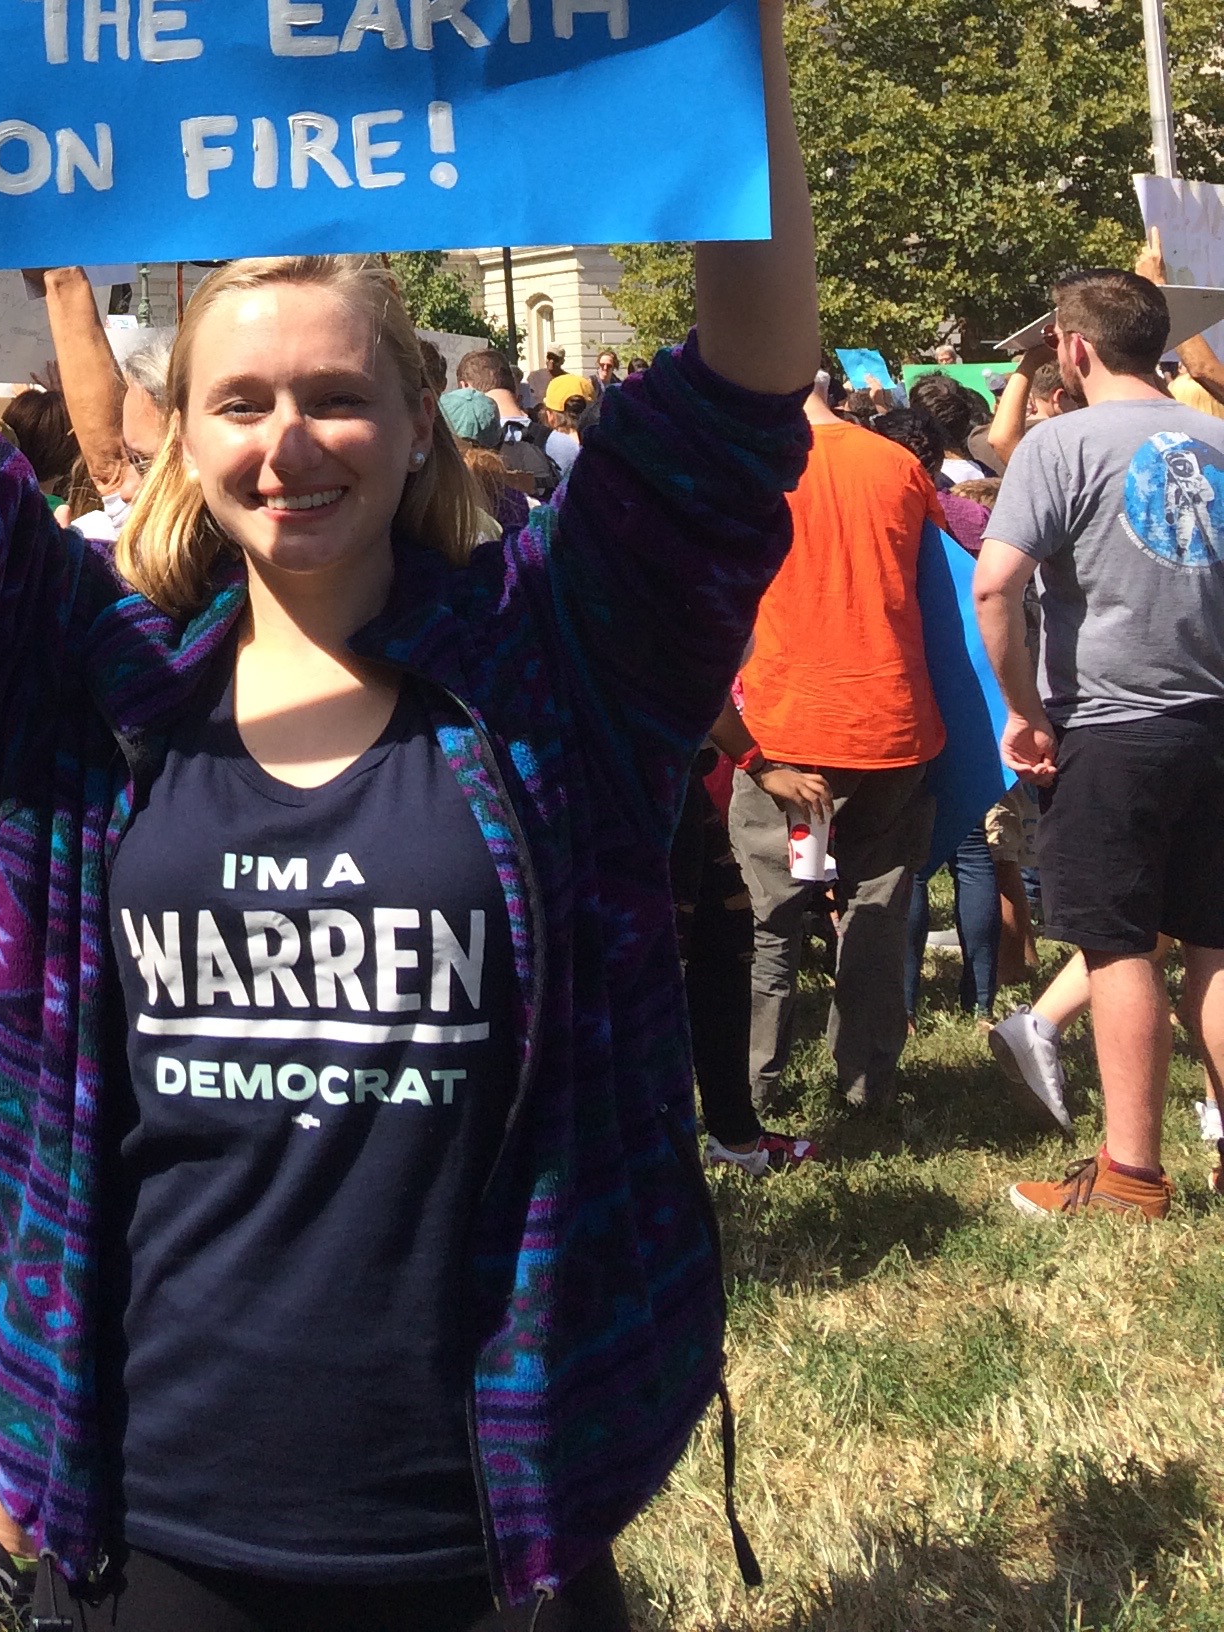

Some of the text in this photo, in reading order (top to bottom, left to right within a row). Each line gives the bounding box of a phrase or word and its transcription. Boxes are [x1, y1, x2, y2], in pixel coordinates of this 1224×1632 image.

[180, 101, 458, 200] FIRE!
[223, 852, 365, 890] I'M A
[121, 908, 485, 1012] WARREN
[155, 1056, 467, 1106] DEMOCRAT
